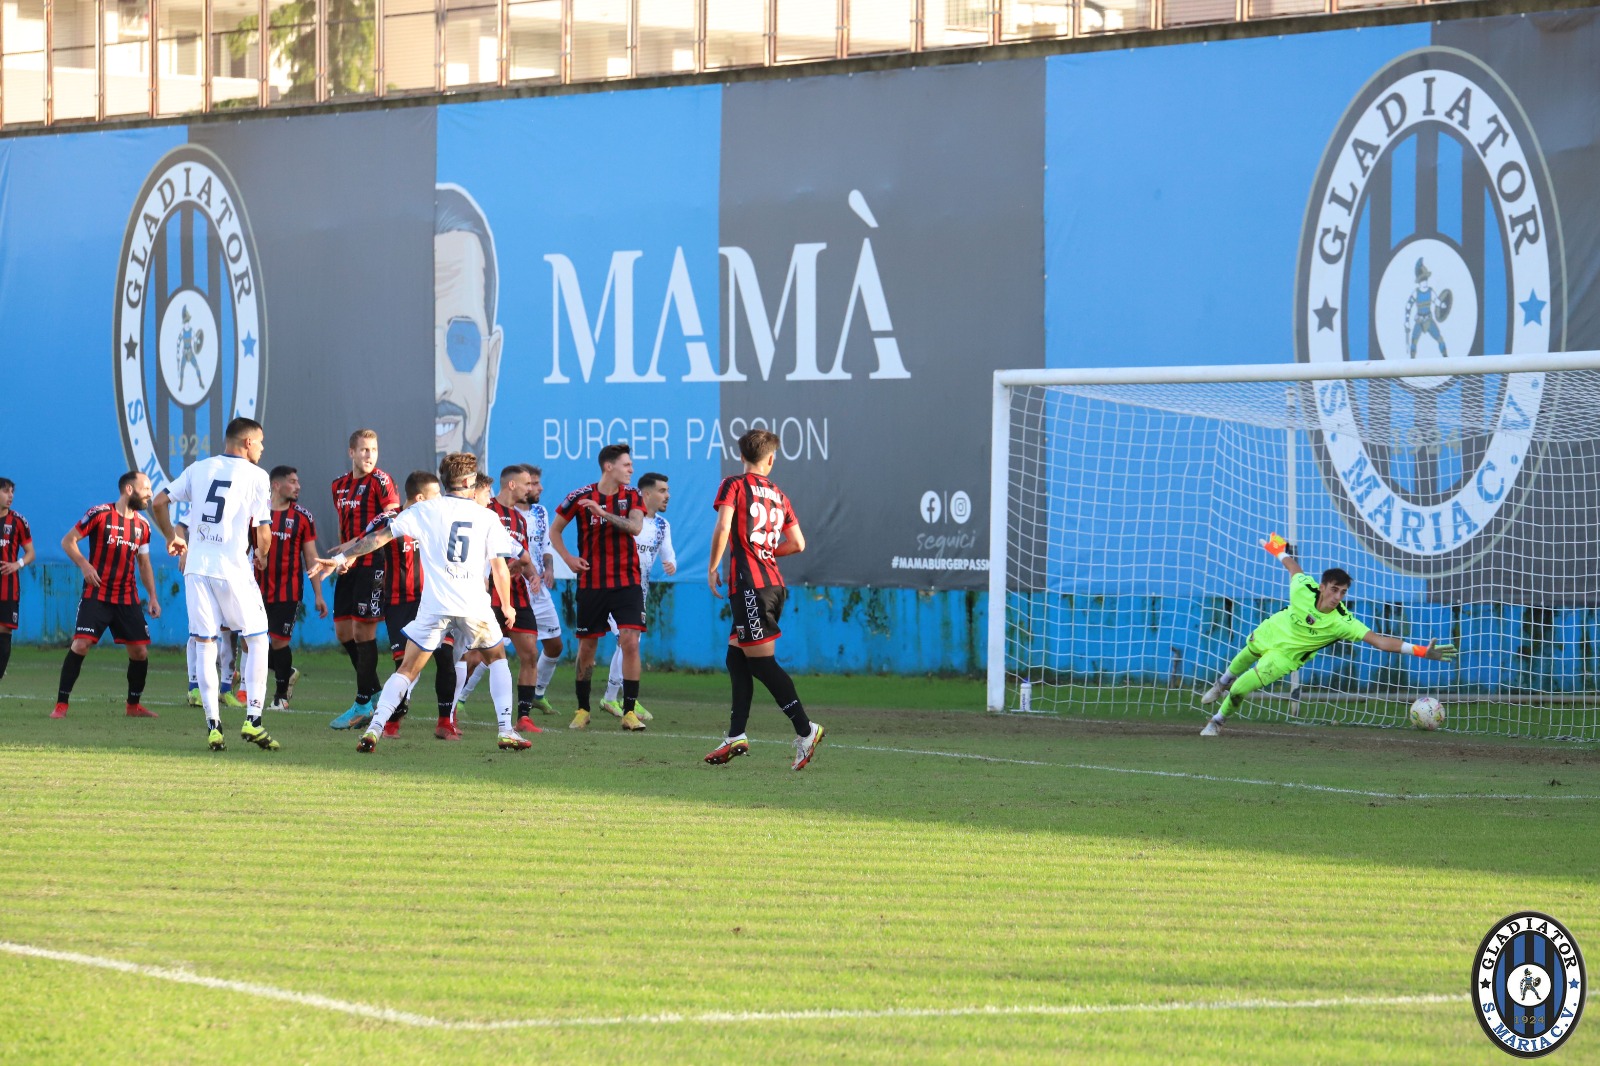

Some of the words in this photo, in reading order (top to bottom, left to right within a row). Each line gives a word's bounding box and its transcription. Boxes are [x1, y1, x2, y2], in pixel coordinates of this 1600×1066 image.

[1319, 76, 1540, 265] GLADIATOR
[126, 166, 252, 309] GLADIATOR
[543, 189, 911, 385] MAMÀ
[169, 433, 210, 457] 1924
[544, 417, 670, 461] BURGER
[202, 479, 232, 523] 5
[1341, 450, 1479, 551] MARIA
[447, 520, 473, 563] 6
[750, 502, 784, 549] 23
[916, 529, 976, 560] seguici
[891, 555, 990, 571] #MAMABURGERPASSI
